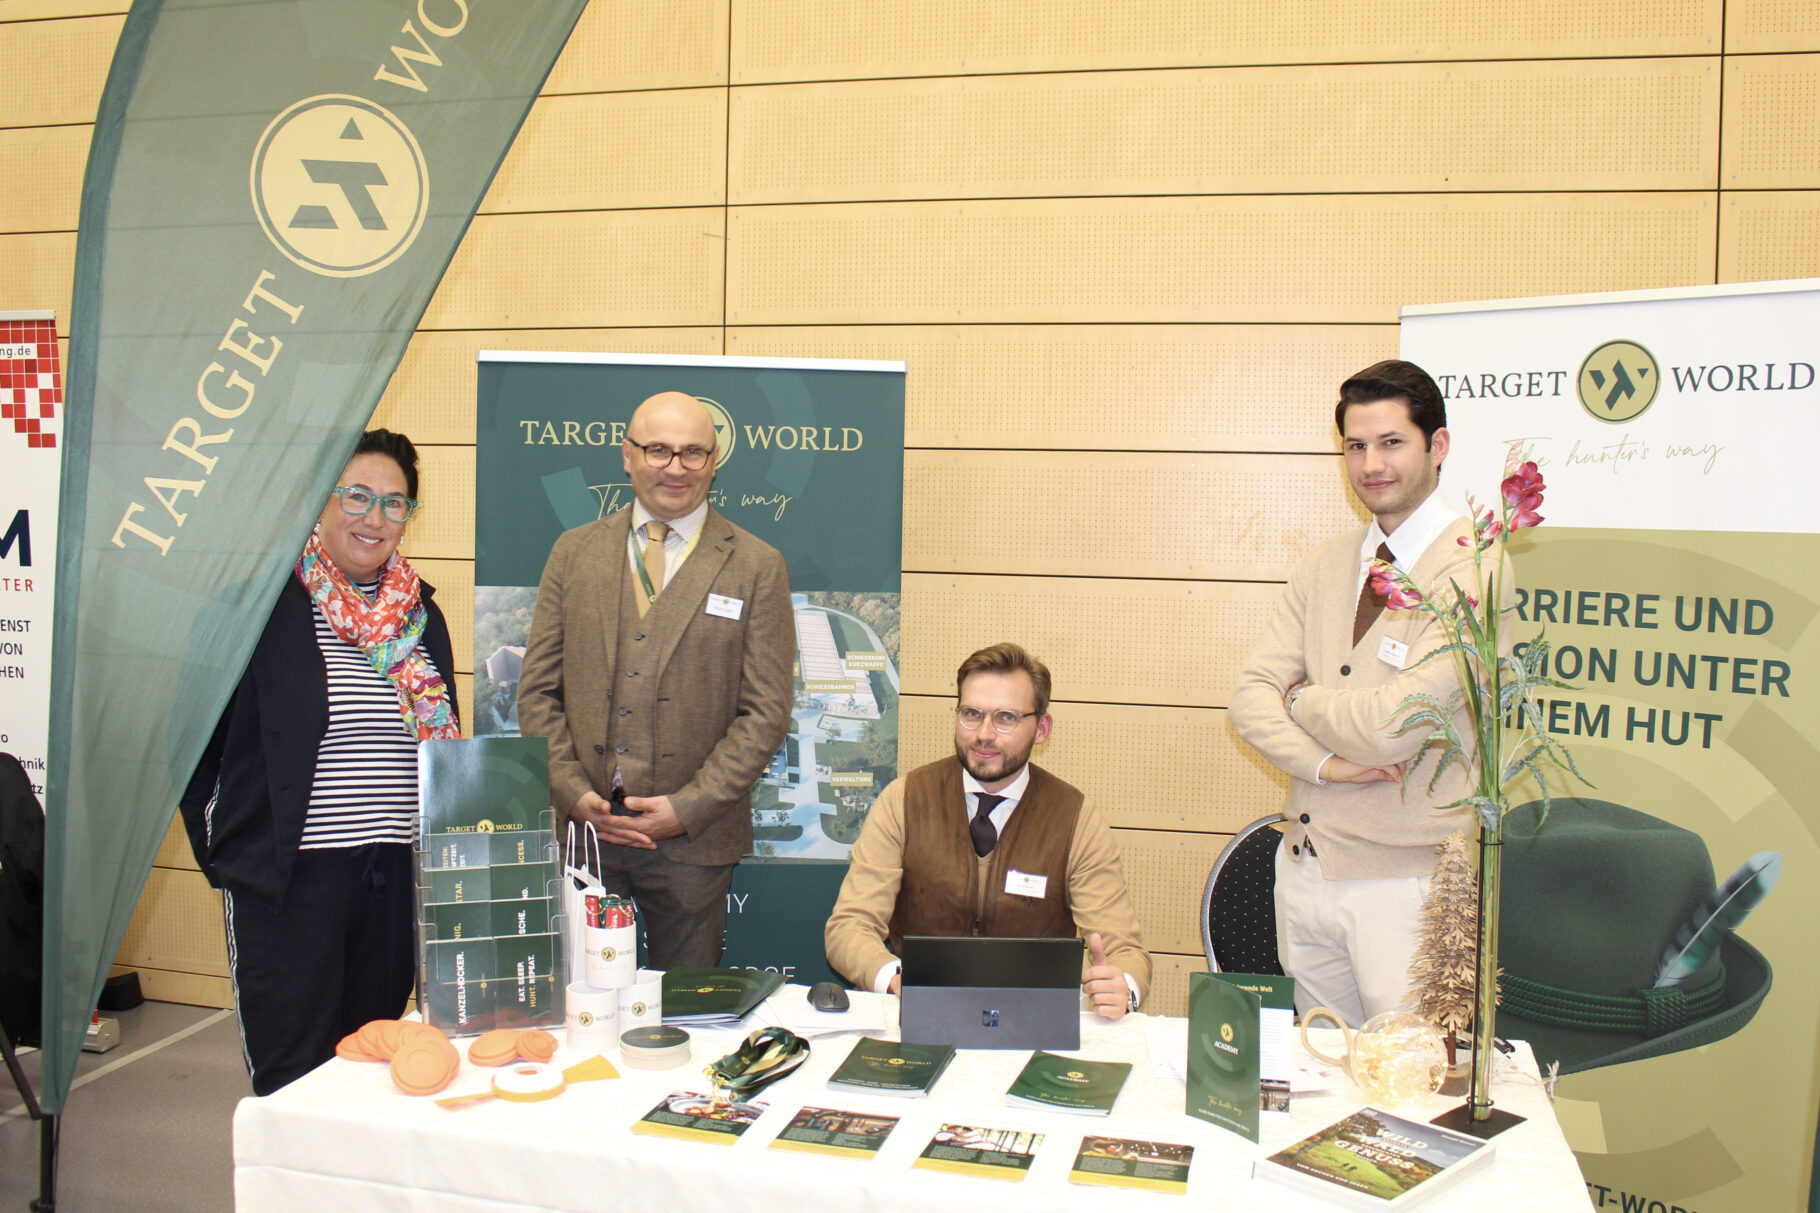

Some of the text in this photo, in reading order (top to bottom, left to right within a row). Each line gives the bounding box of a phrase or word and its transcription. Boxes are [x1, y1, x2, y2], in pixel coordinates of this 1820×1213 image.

[1438, 362, 1815, 399] TARGET WORLD
[111, 269, 305, 557] TARGET
[520, 420, 863, 452] TARGE WORLD
[1565, 433, 1650, 473] hunter's
[1666, 439, 1727, 475] way
[741, 493, 793, 521] way
[0, 578, 34, 592] TER
[1675, 595, 1774, 636] UND
[1634, 650, 1792, 698] UNTER
[1625, 706, 1723, 750] HUT
[446, 823, 523, 833] TARGET WORLD
[518, 986, 526, 1002] EAT.
[528, 954, 537, 1008] HUNT. REPEAT.
[1334, 1140, 1416, 1169] GENUSS
[1376, 1128, 1429, 1149] WILD
